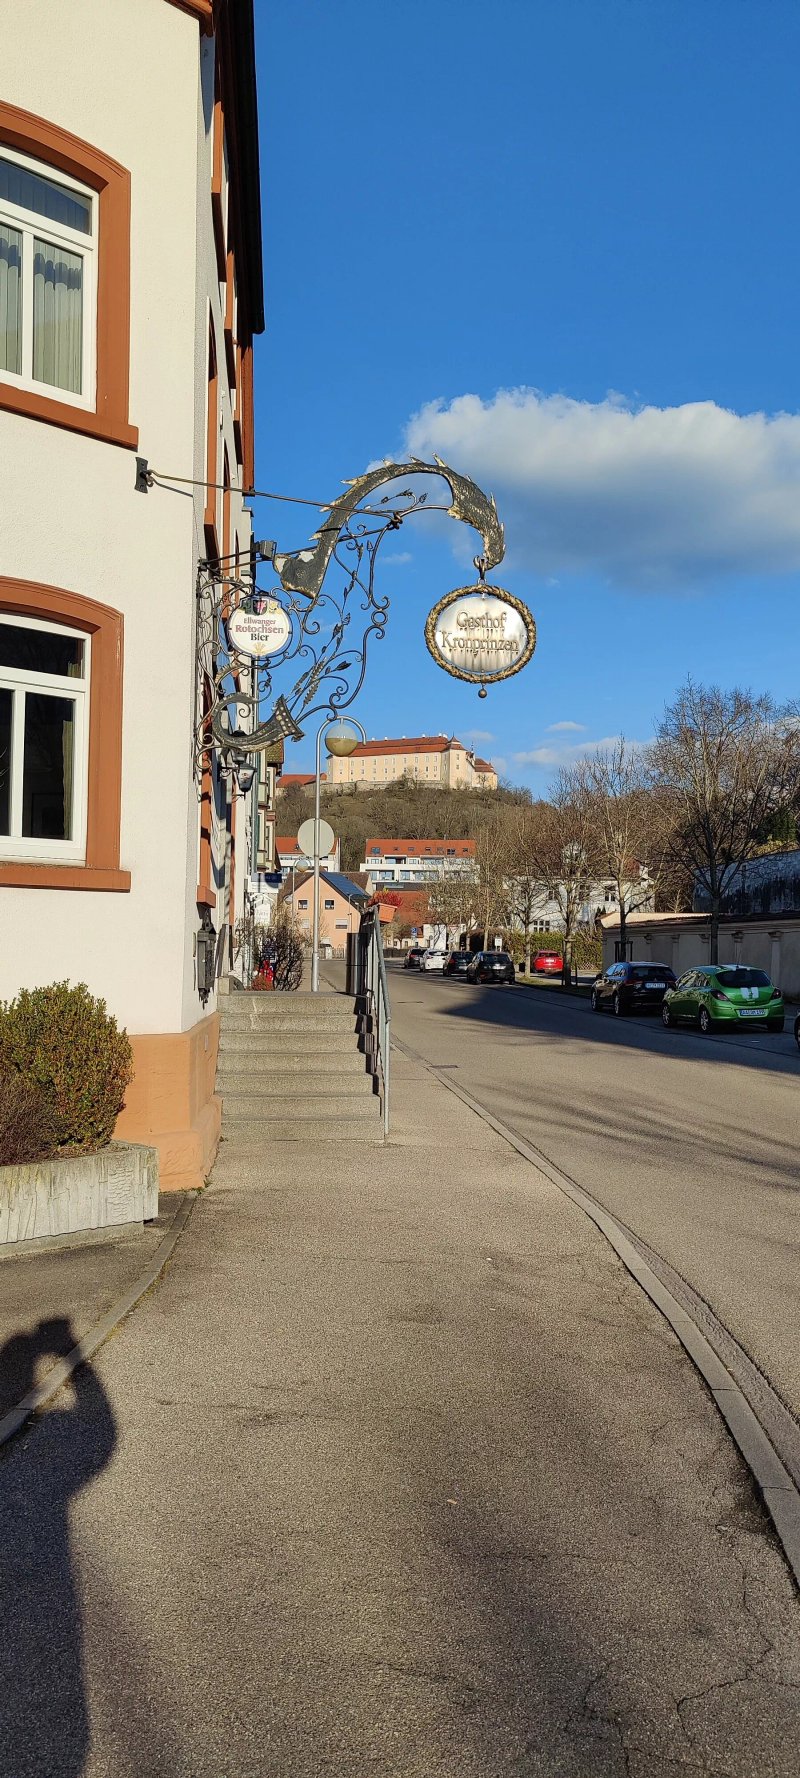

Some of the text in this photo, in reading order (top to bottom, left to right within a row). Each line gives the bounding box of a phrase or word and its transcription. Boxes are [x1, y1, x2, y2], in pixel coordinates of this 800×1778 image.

[243, 617, 276, 627] Ellwanger
[456, 611, 507, 629] Gasthof
[235, 625, 284, 634] Rotochsen
[250, 633, 270, 641] Bier
[441, 631, 519, 652] Kronprinzen
